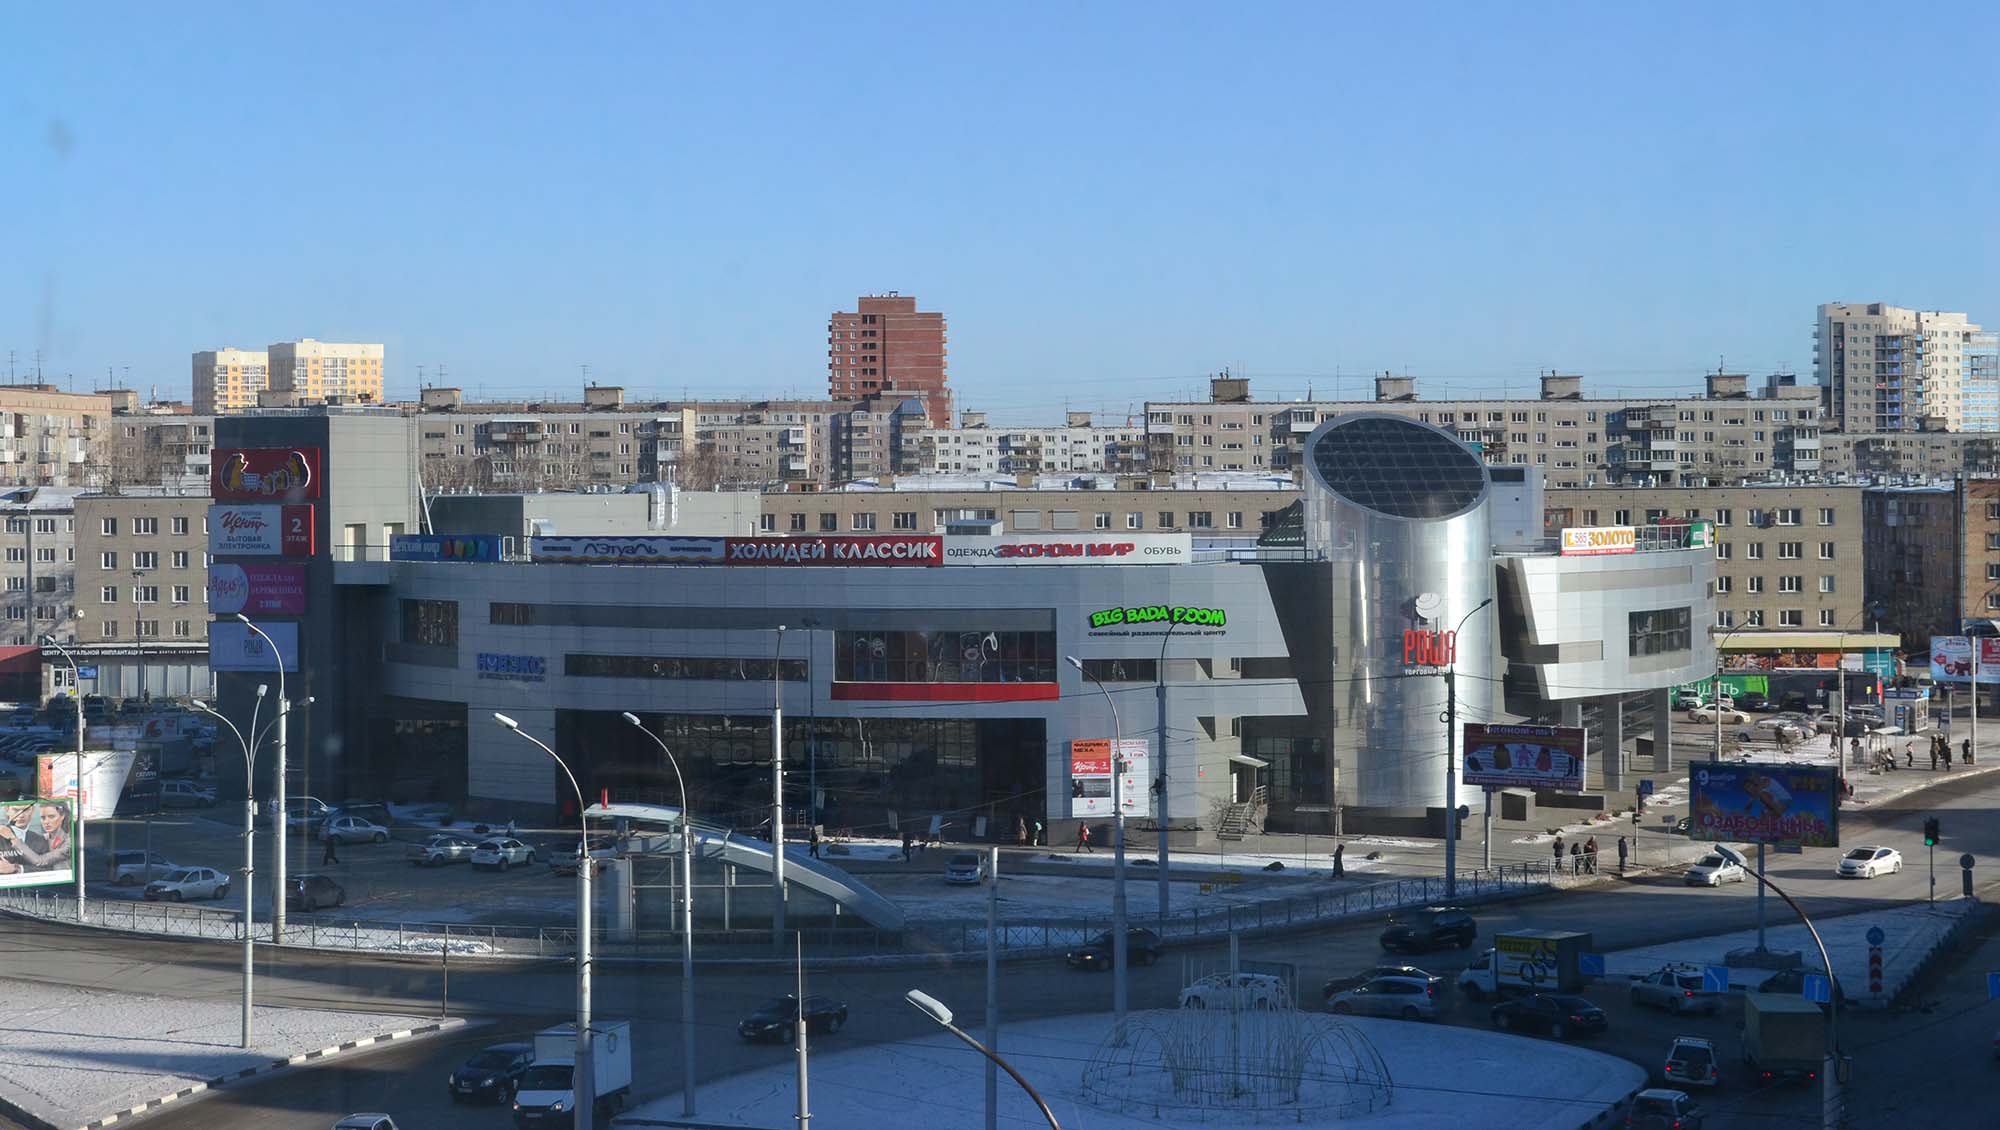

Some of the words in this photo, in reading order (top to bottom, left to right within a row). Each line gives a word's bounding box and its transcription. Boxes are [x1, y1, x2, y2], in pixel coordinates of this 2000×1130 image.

[220, 511, 269, 534] Центр
[291, 518, 302, 532] 2
[1574, 532, 1587, 544] 585
[1588, 530, 1634, 547] ЗОЛОТО
[730, 539, 826, 562] ХОЛИДЕЙ
[833, 542, 937, 559] КЛАССИК
[947, 547, 995, 557] ОДЕЖДА
[995, 543, 1083, 558] ЭКОНОМ
[1086, 542, 1135, 557] МИР
[1144, 546, 1182, 555] ОБУВЬ
[1090, 607, 1124, 628] BIG
[1125, 605, 1169, 623] BADA
[1699, 769, 1709, 785] 9
[1702, 814, 1825, 834] ОЗАБОЧЕННЫЕ
